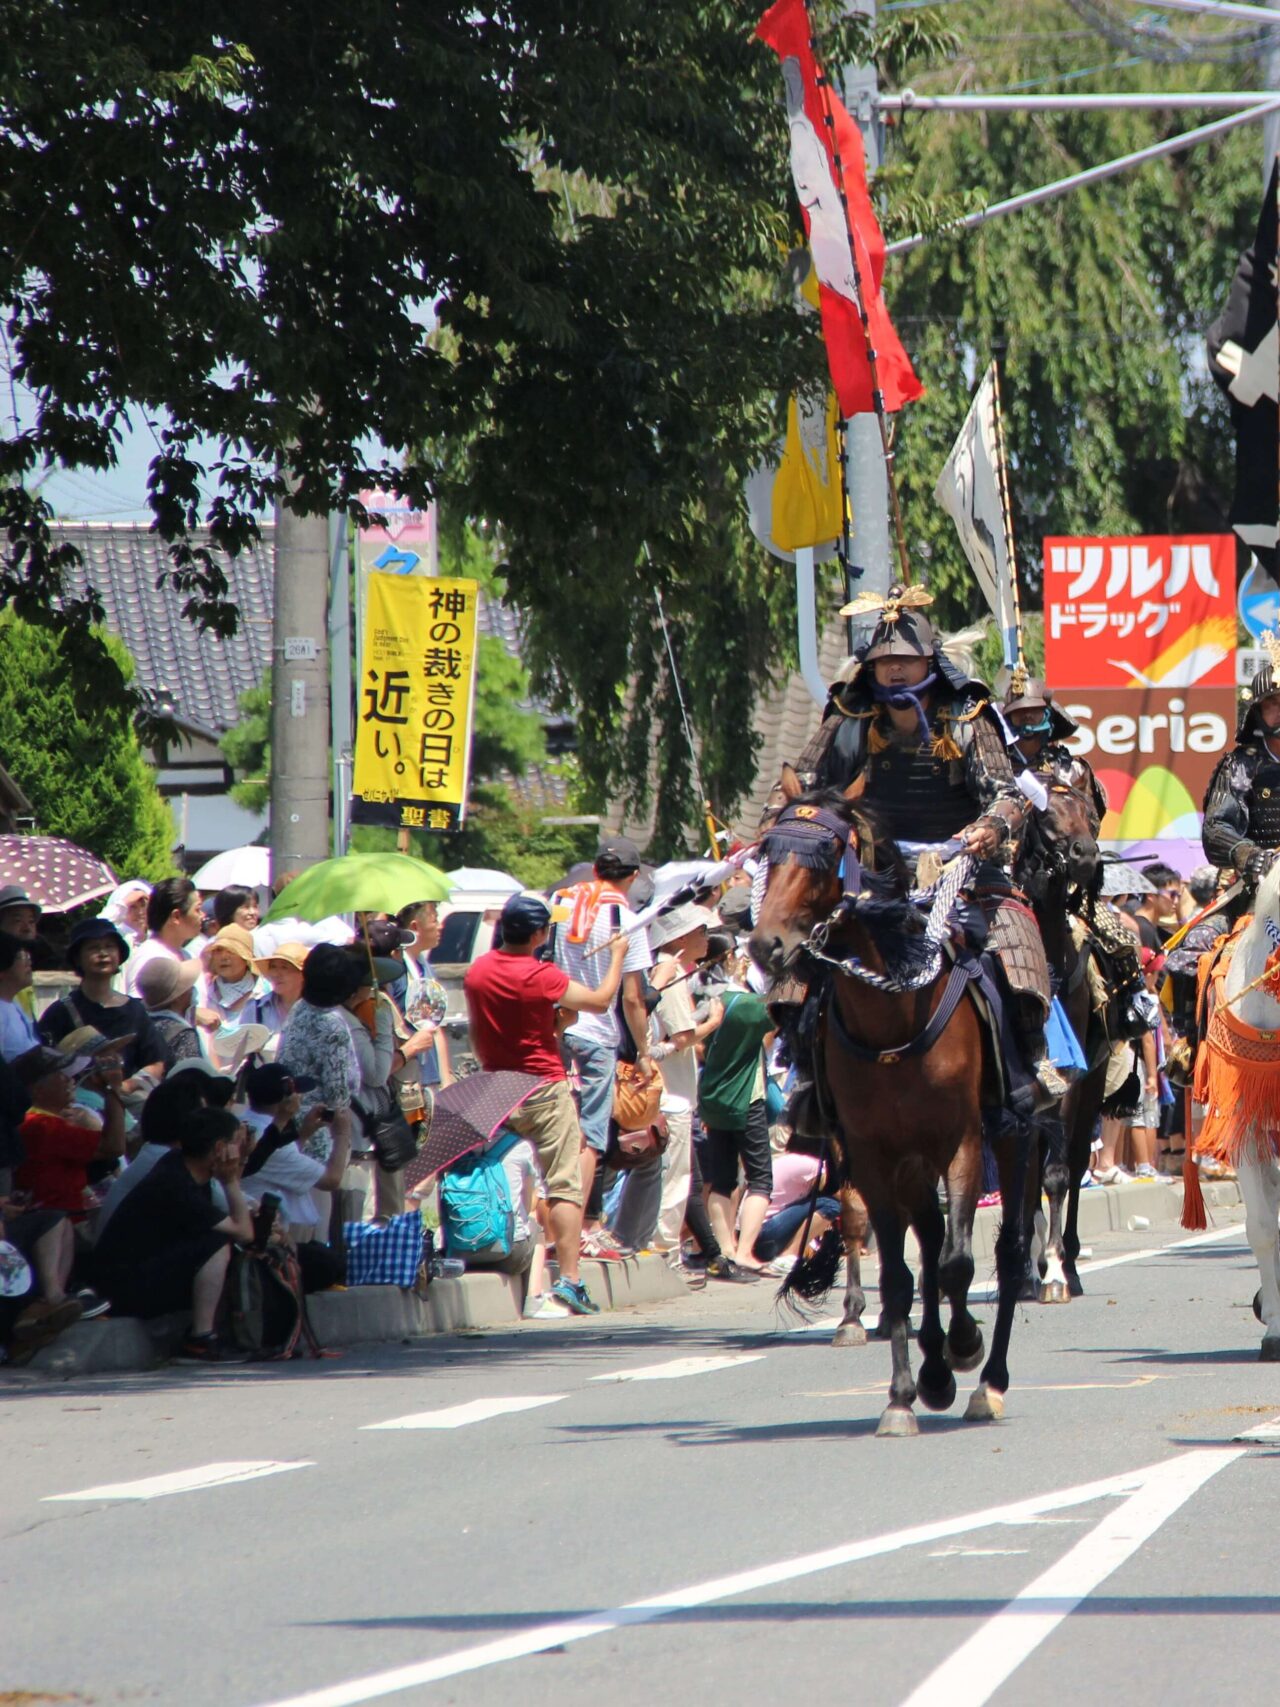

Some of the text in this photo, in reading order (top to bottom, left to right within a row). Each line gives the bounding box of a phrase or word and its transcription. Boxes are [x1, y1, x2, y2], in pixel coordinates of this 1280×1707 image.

[1050, 545, 1220, 599] ツルハ
[1050, 601, 1181, 639] ドラッグ
[419, 588, 466, 788] 神の裁きの日は
[363, 669, 410, 775] 近い。
[1058, 697, 1228, 756] Seria
[401, 806, 451, 829] 聖書
